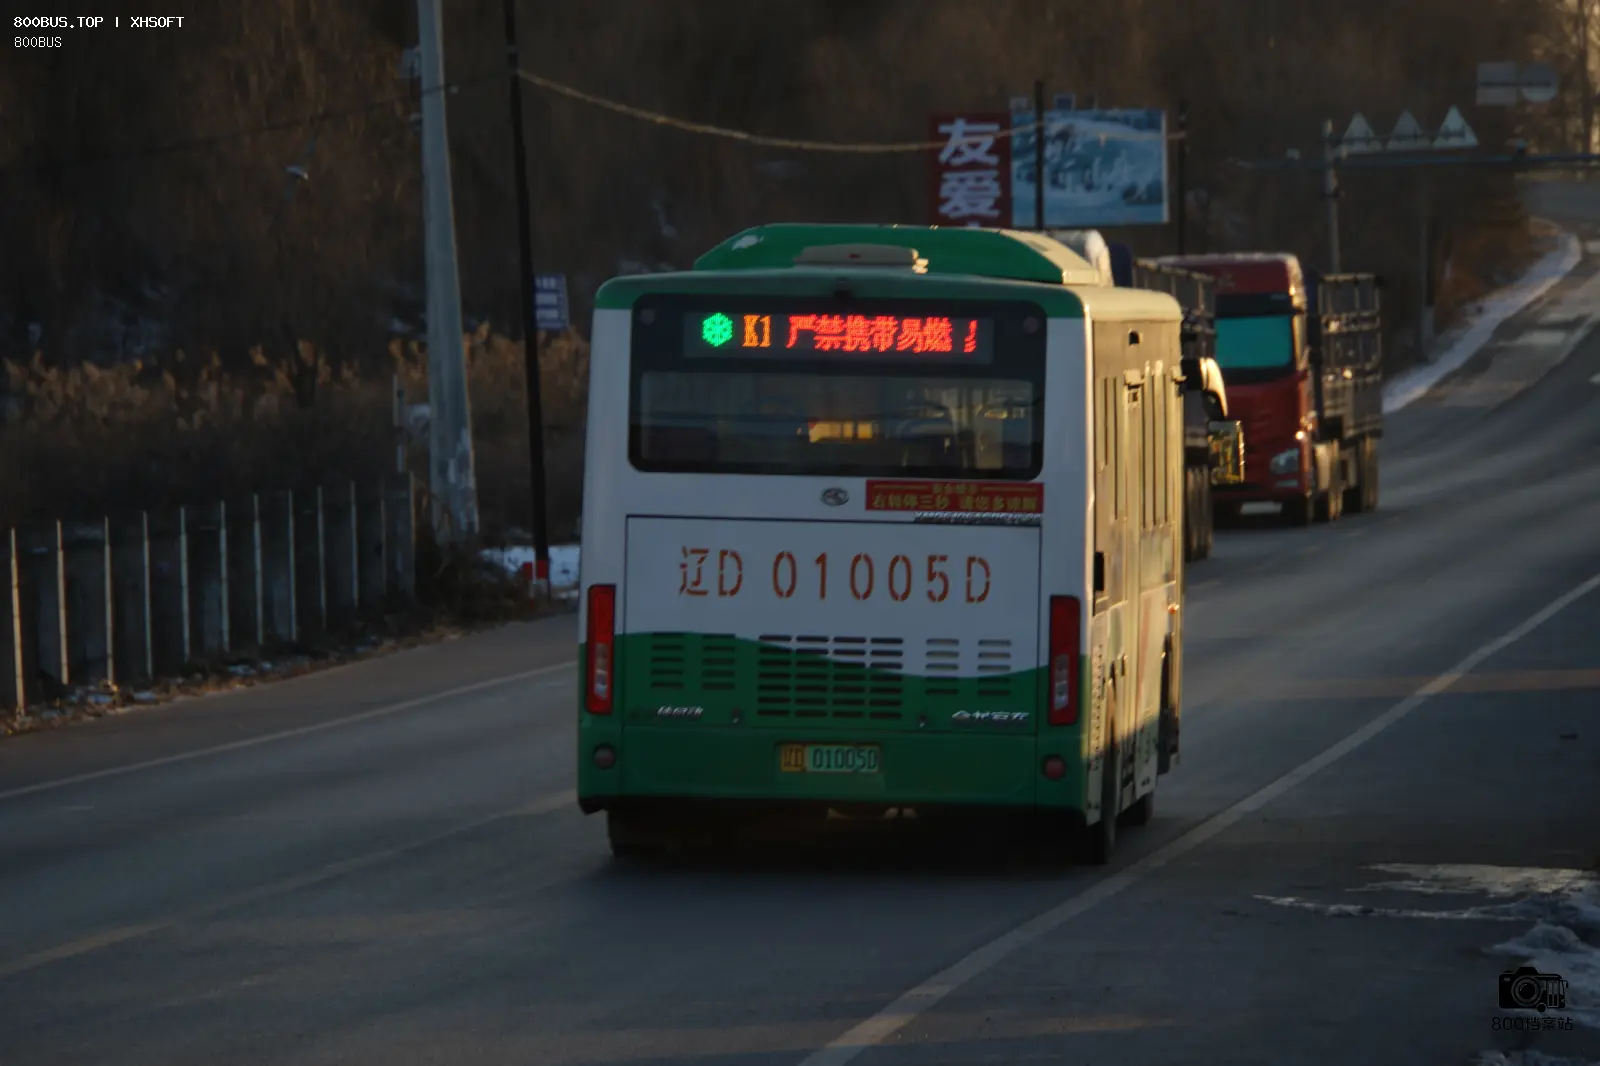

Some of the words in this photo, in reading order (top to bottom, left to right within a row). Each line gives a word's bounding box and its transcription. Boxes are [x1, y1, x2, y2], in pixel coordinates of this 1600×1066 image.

[938, 117, 1001, 228] 友爱
[742, 314, 771, 348] K1
[786, 314, 953, 353] 严禁携带易燃
[679, 546, 743, 597] 辽D
[772, 551, 991, 603] 01005D
[813, 748, 877, 770] 01005D
